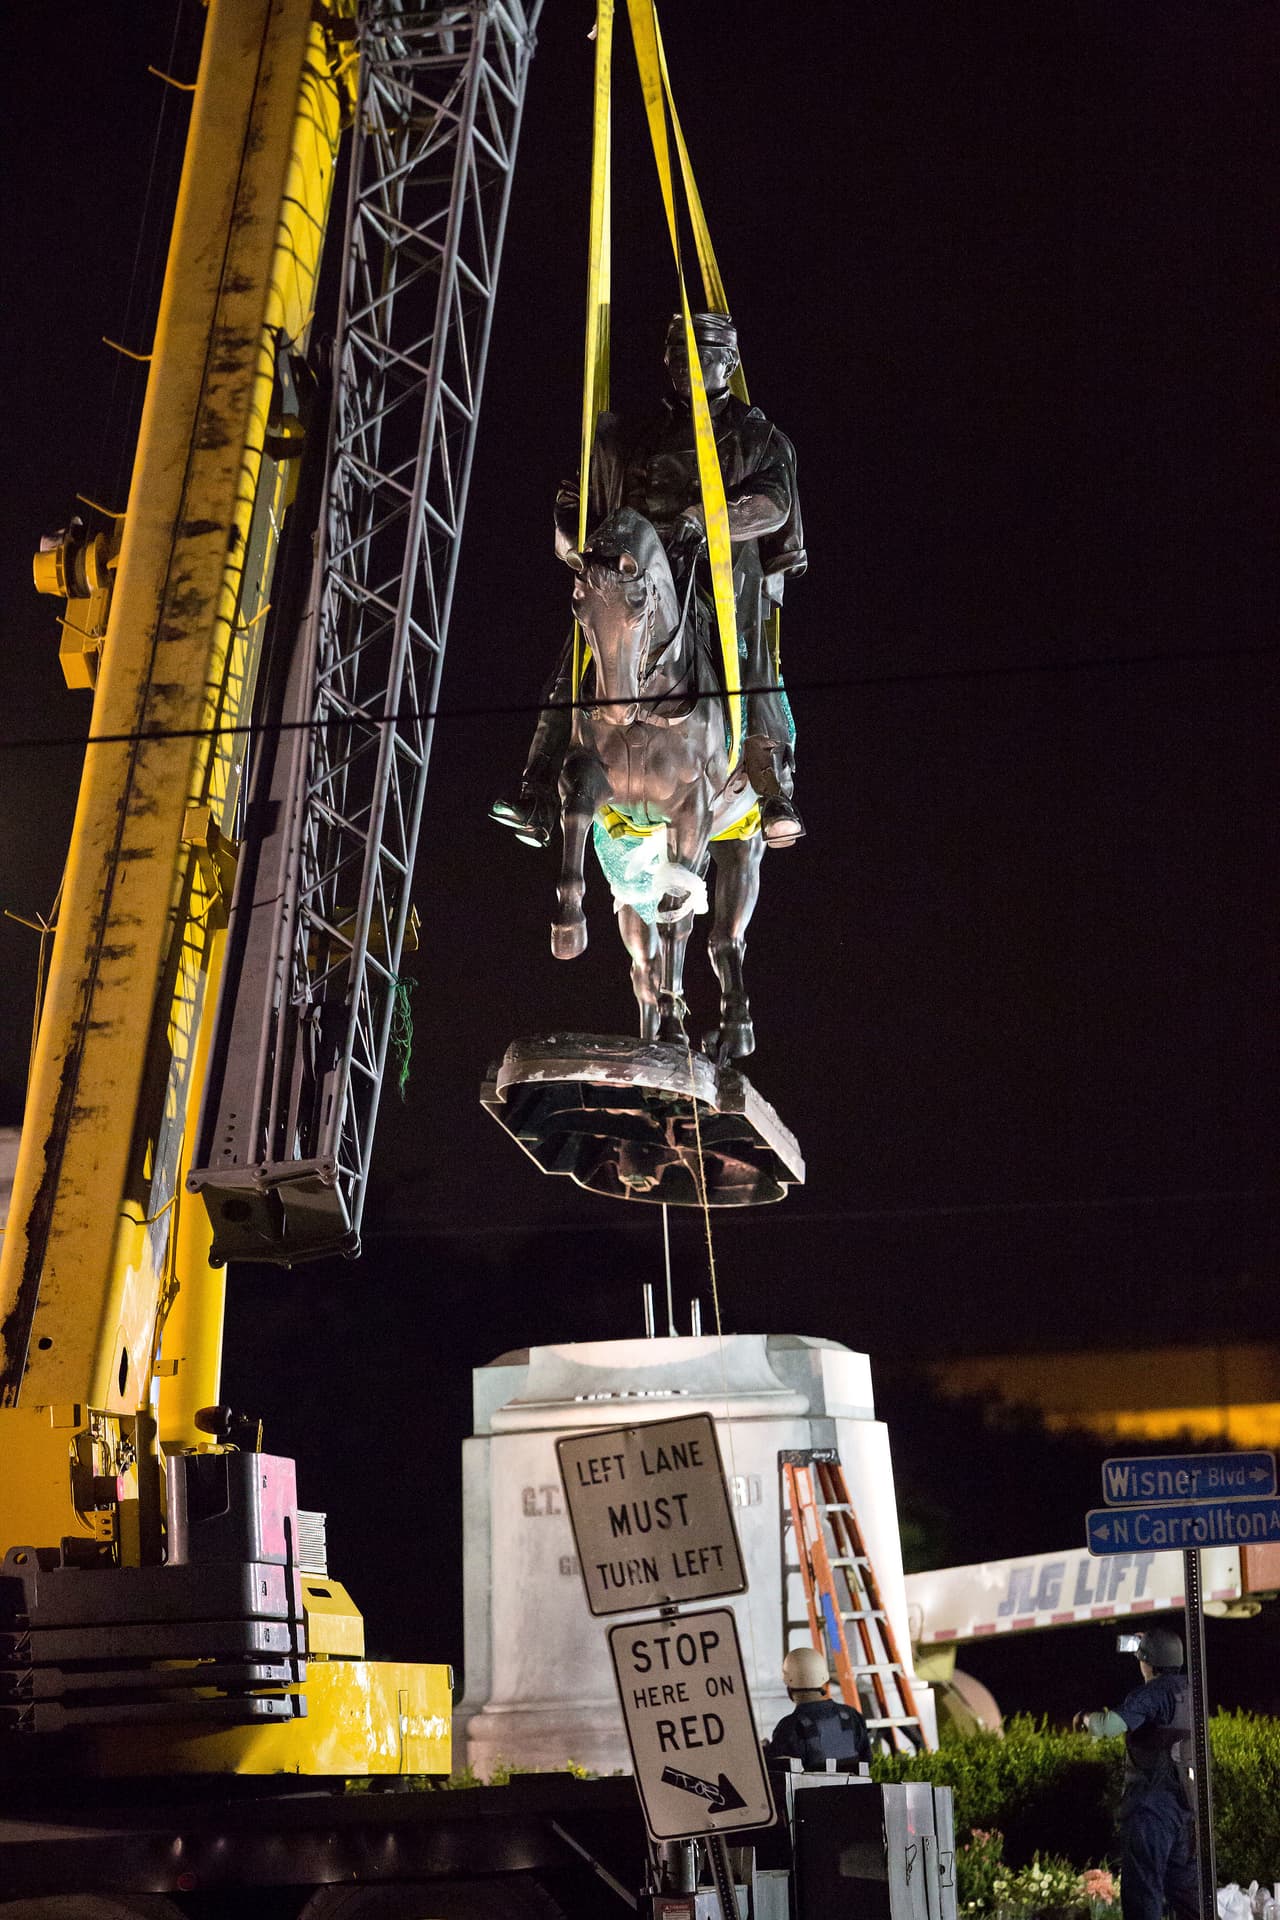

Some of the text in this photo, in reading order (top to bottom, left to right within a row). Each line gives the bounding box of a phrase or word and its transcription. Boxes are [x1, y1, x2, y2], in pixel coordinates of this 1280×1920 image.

[576, 1441, 703, 1487] LEFT LANE
[1107, 1465, 1245, 1497] Wisner Blvd
[608, 1493, 689, 1538] MUST
[1113, 1519, 1129, 1544] N
[1134, 1508, 1268, 1545] Carrollton
[596, 1557, 660, 1590] TURN
[672, 1545, 724, 1579] LEFT
[1073, 1552, 1156, 1606] LIFT
[631, 1630, 720, 1673] STOP
[633, 1675, 735, 1709] HERE ON
[656, 1713, 725, 1752] RED
